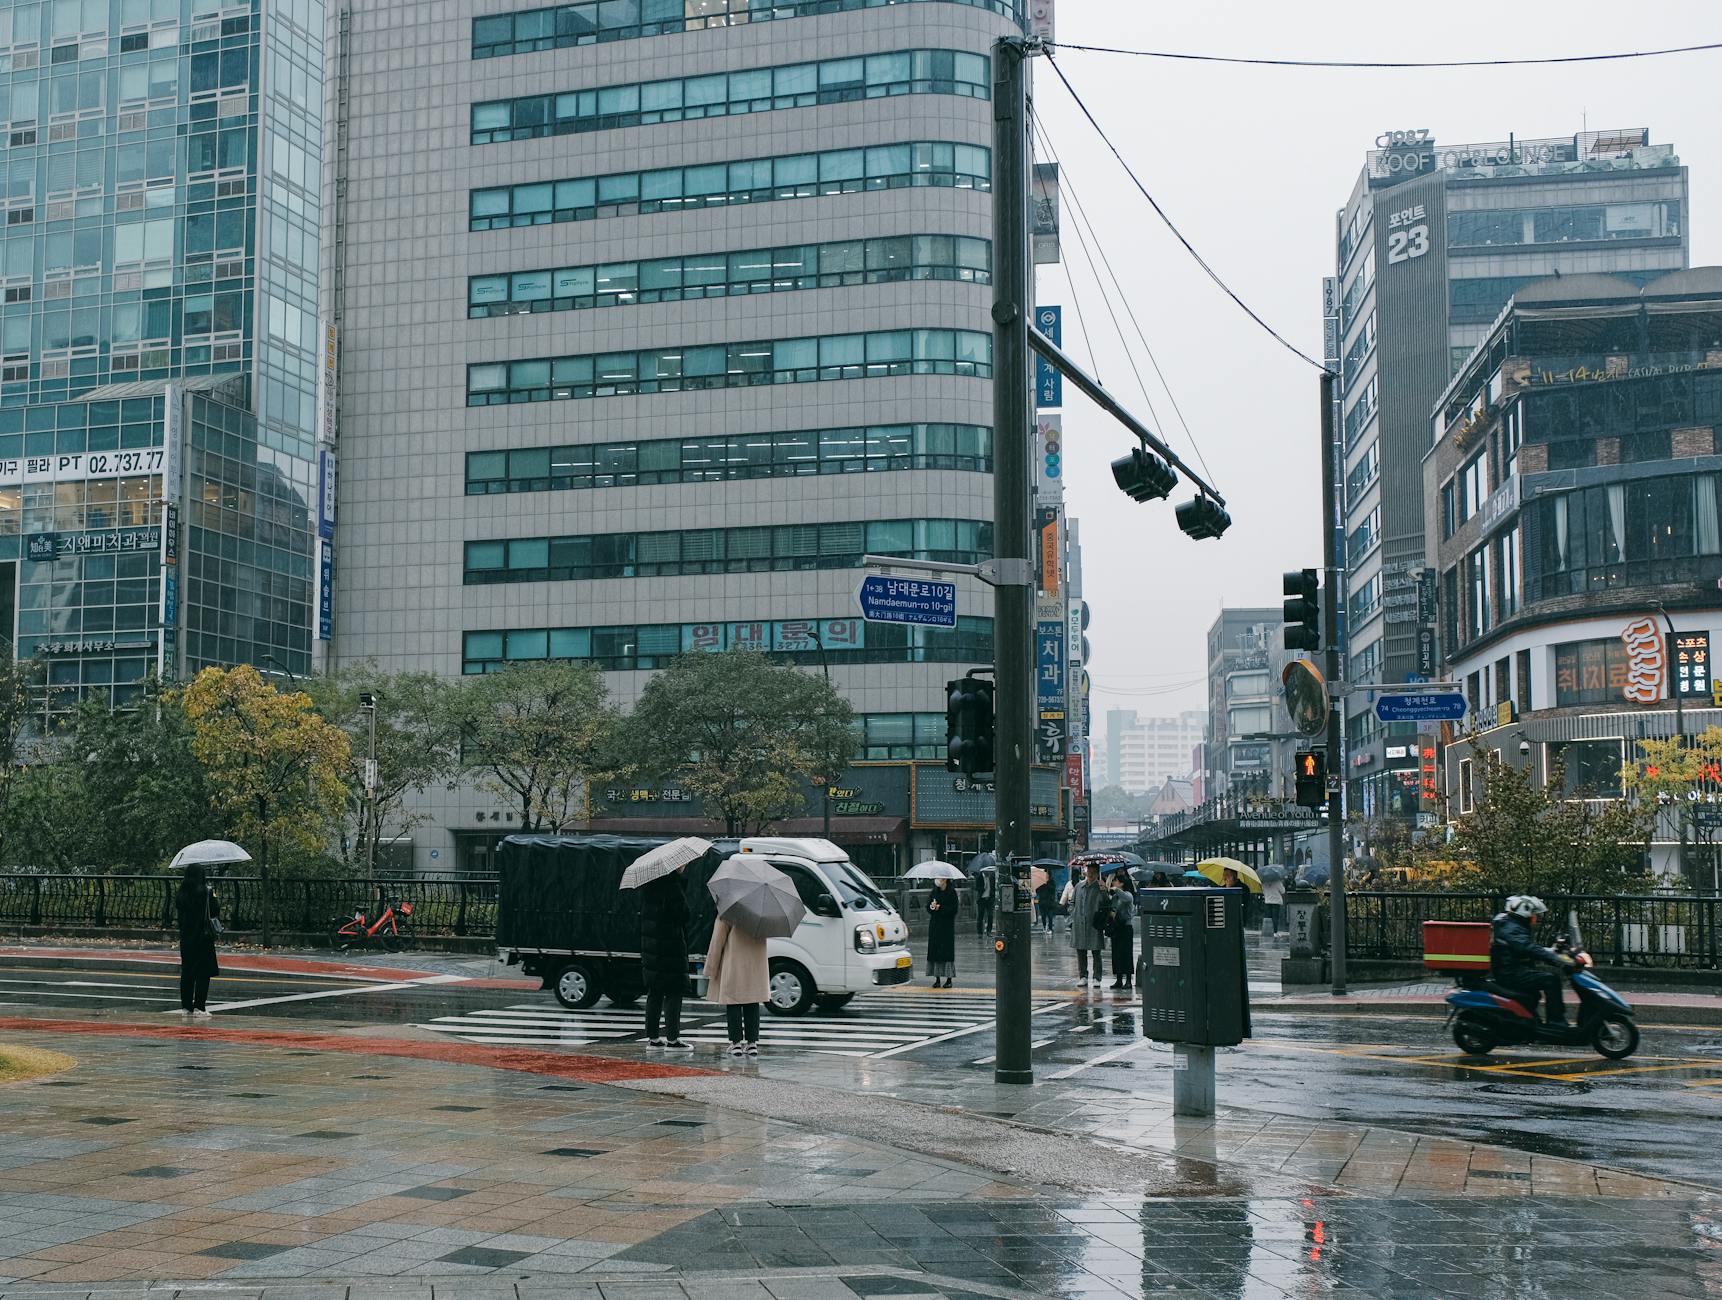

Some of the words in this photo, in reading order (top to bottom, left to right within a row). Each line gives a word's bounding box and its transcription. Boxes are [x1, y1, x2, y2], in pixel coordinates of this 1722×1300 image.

[1388, 205, 1426, 229] 포인트
[1388, 224, 1429, 264] 23
[59, 455, 82, 471] PT
[887, 581, 953, 601] 남대문로10길
[868, 595, 929, 610] Namdaemun-ro
[931, 601, 953, 613] 10-gil
[1676, 636, 1707, 648] 스포츠
[1041, 640, 1061, 685] 치과
[1041, 721, 1065, 754] 휴
[1240, 810, 1277, 820] Avenue
